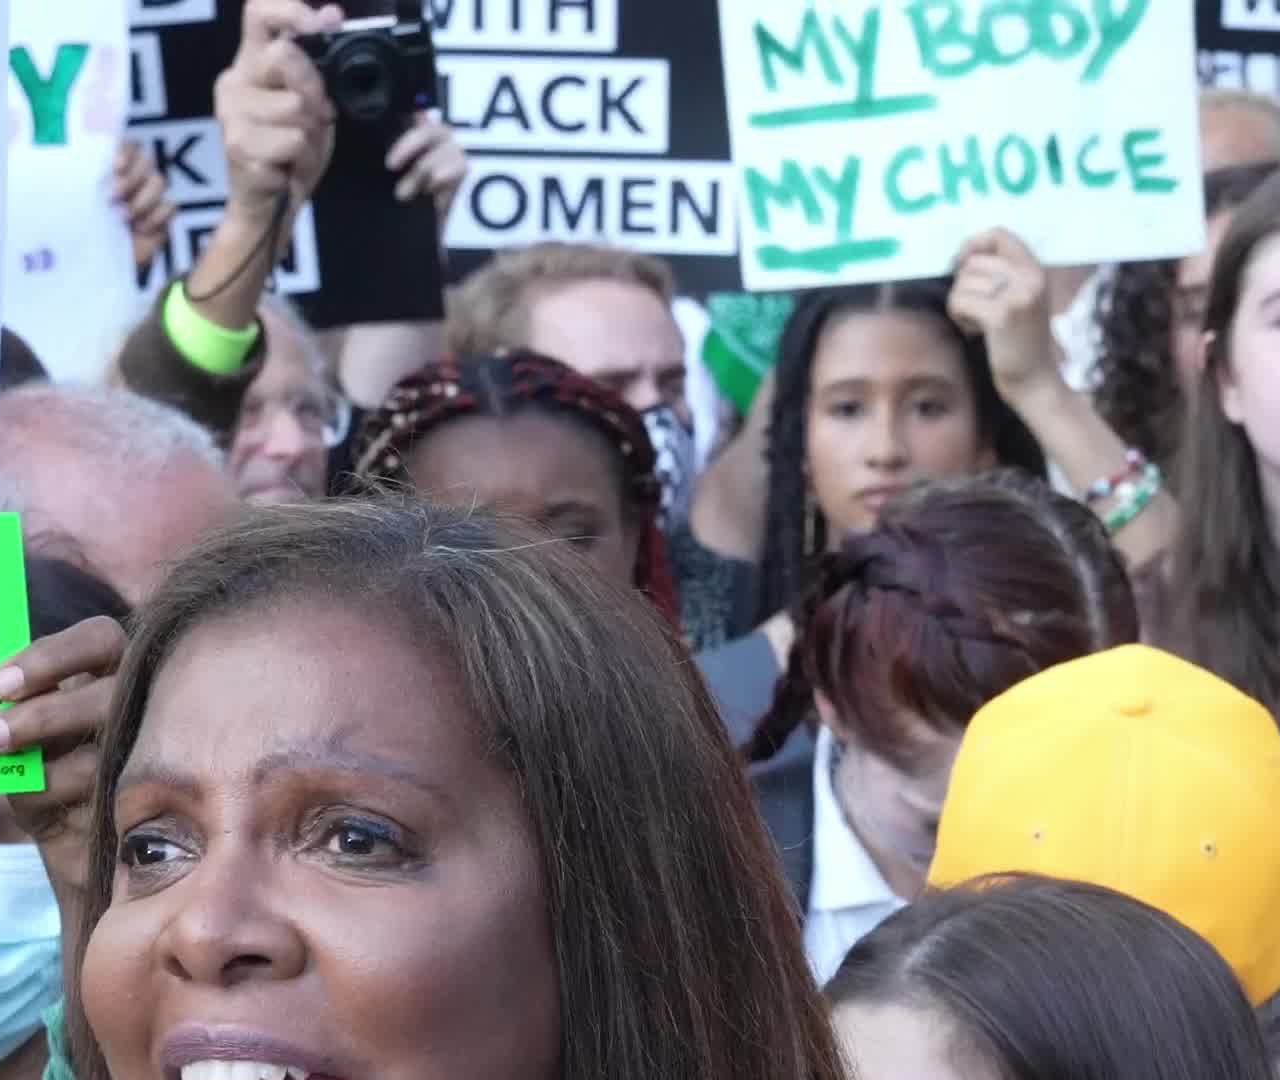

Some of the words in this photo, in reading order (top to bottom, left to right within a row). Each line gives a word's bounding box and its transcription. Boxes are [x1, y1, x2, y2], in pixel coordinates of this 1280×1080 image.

[753, 6, 881, 114] MY
[905, 0, 1153, 89] BODY
[437, 74, 646, 135] LACK
[469, 173, 721, 236] OMEN
[744, 154, 862, 242] MY
[883, 126, 1179, 215] CHOICE
